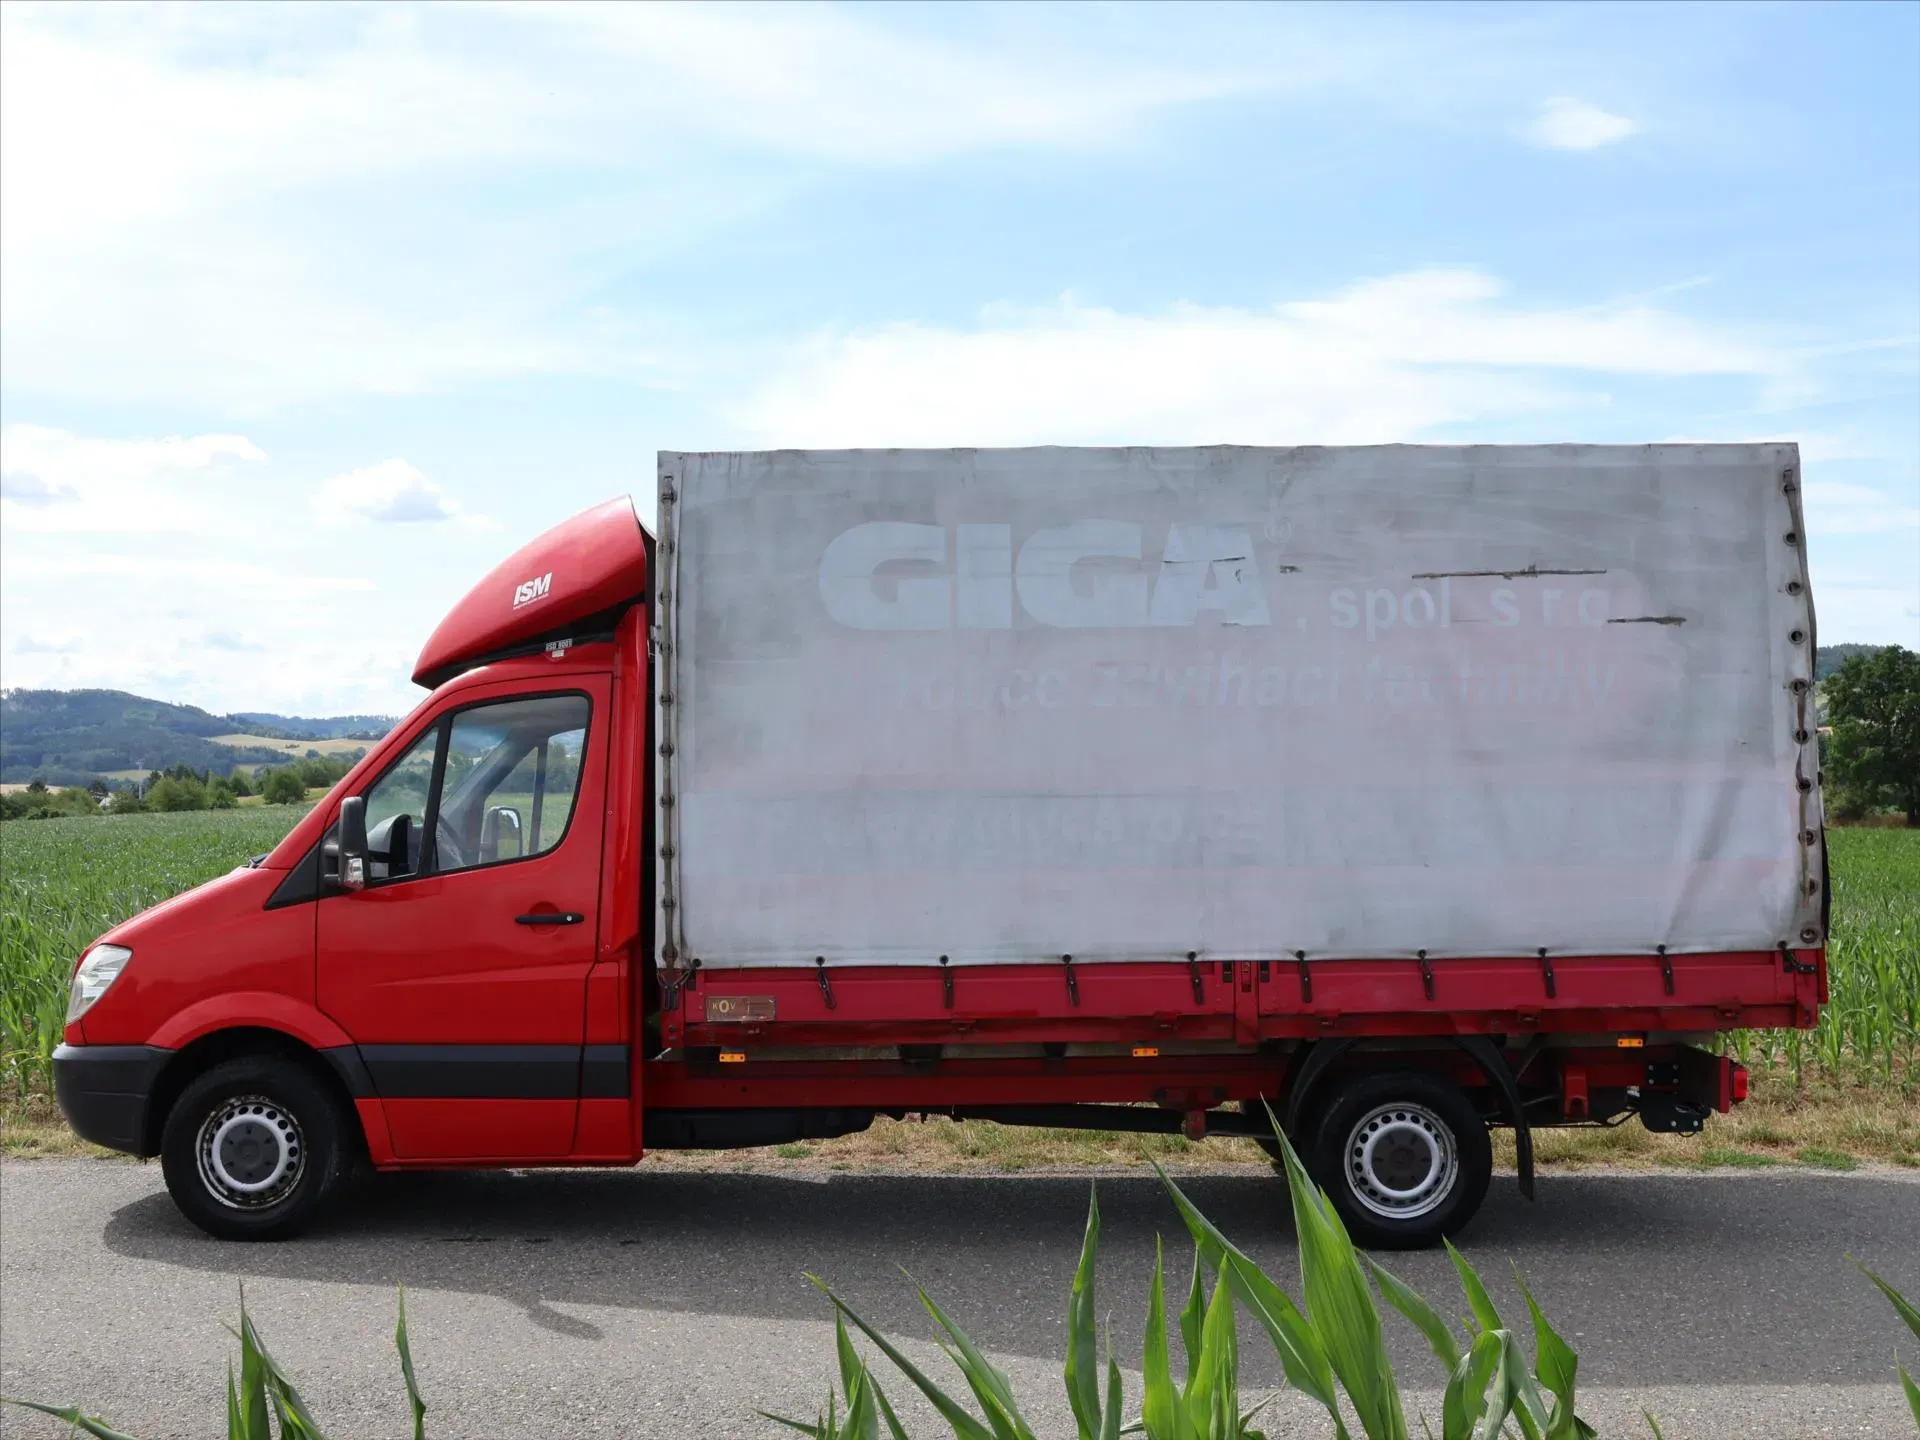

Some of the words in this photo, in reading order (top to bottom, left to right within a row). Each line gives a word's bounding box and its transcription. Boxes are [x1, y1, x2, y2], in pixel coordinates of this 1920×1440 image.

[513, 571, 552, 606] ISM
[819, 519, 1271, 631] GIGA
[1329, 577, 1450, 642] spol
[1489, 587, 1520, 628] s
